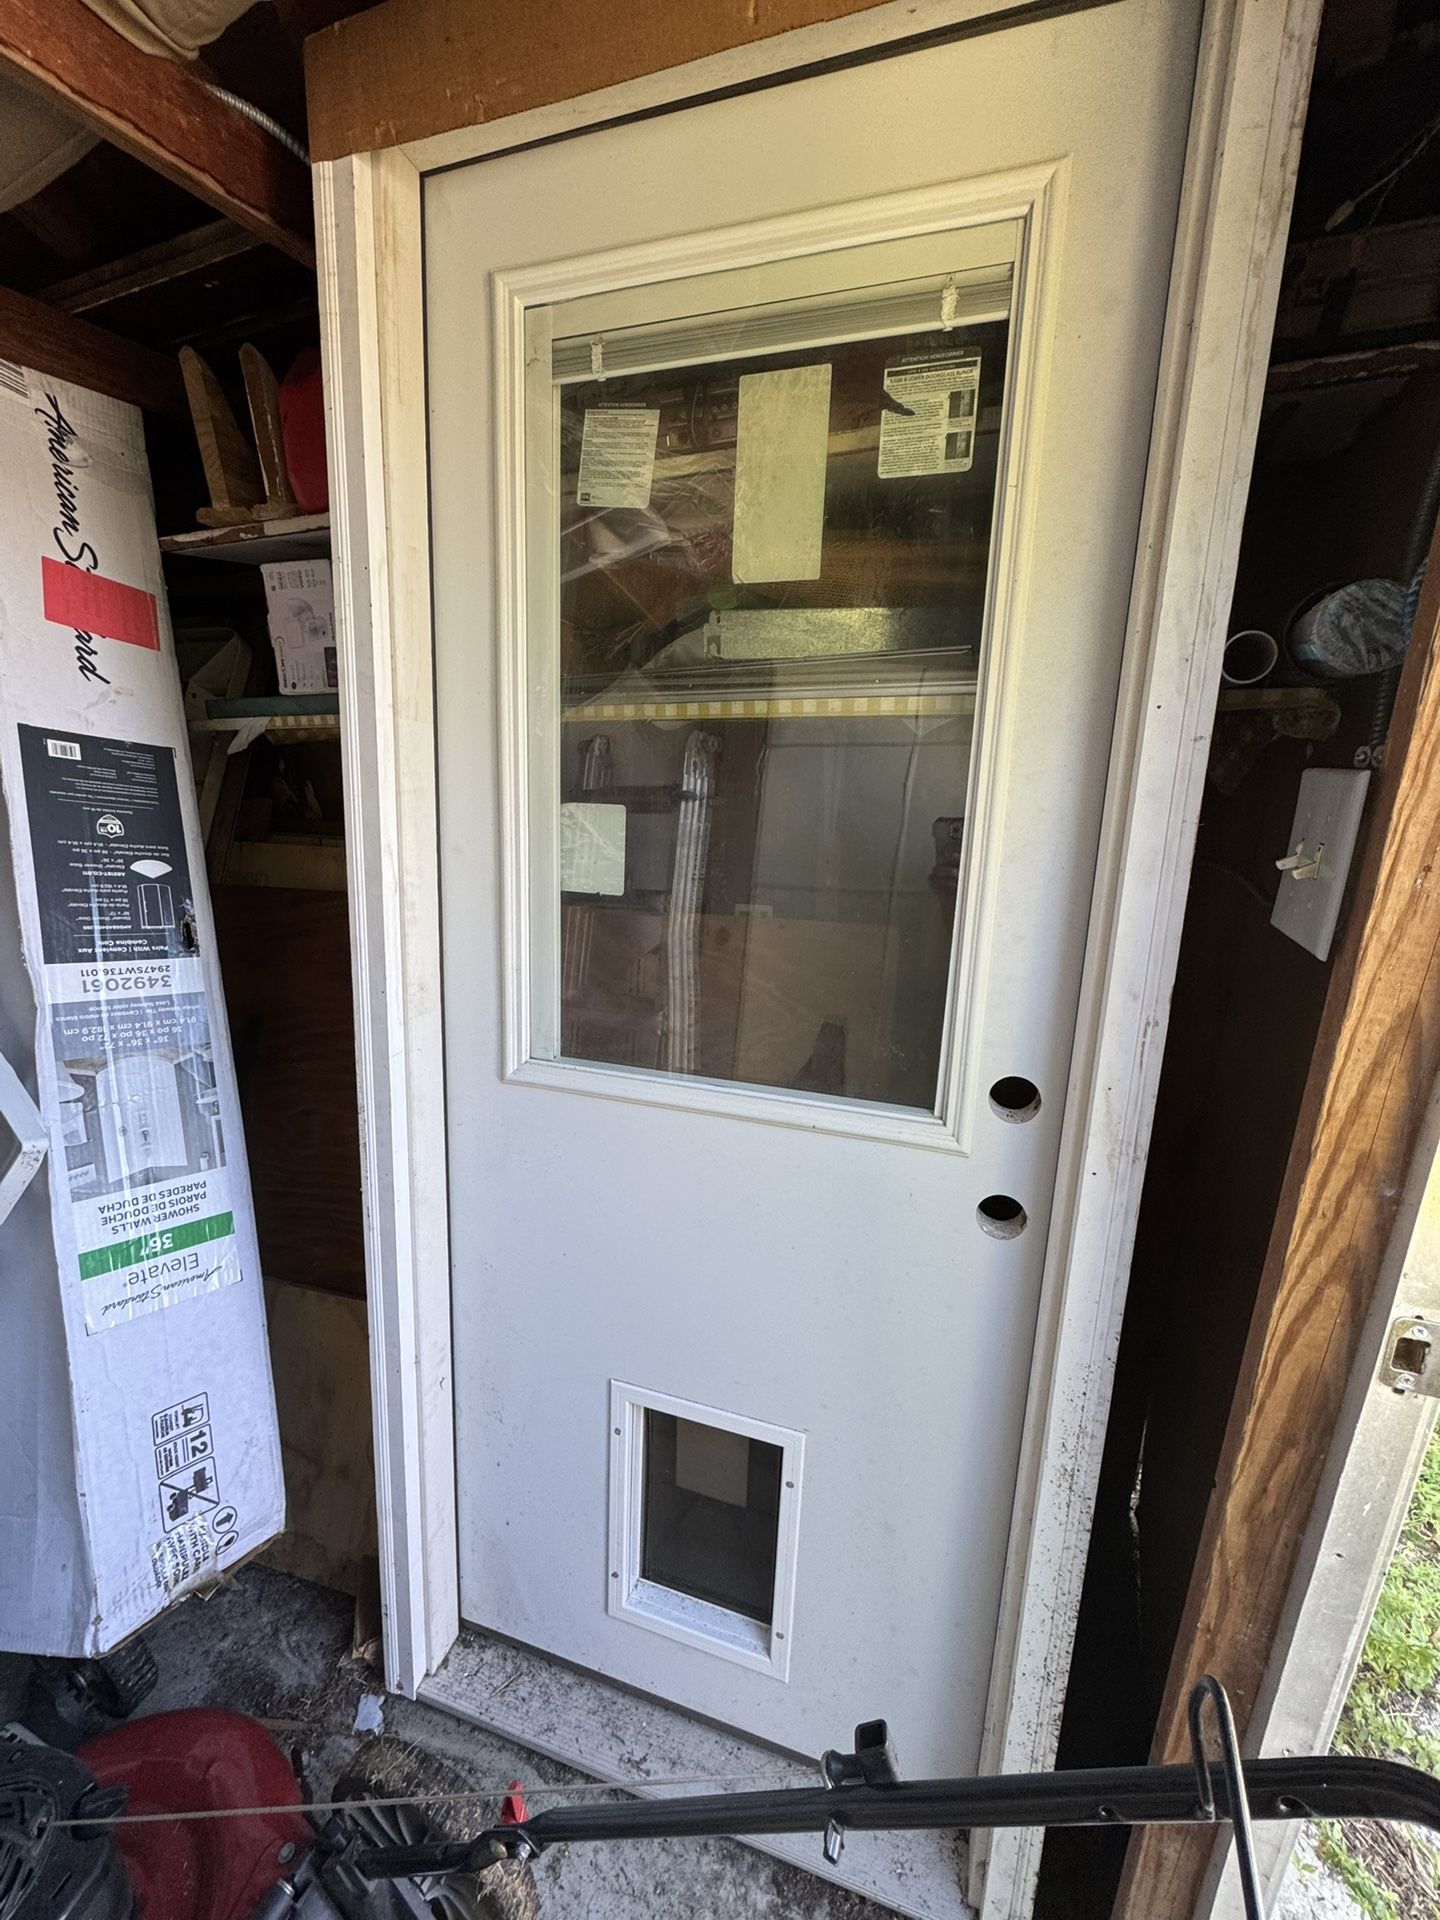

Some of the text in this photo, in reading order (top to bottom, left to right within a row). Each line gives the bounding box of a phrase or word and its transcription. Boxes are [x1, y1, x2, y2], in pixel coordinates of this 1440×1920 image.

[35, 392, 80, 536] American
[107, 824, 122, 834] 10
[95, 946, 127, 954] Convient
[80, 964, 171, 978] 2947SWT36.011
[81, 974, 172, 994] 3492061
[134, 1020, 153, 1029] 91.4
[163, 1018, 177, 1026] cm
[179, 1016, 197, 1024] 91.4
[64, 1028, 79, 1036] cm
[118, 1023, 132, 1031] cm
[157, 1026, 169, 1034] po
[120, 1030, 132, 1038] po
[98, 1180, 207, 1214] PAREDES DE DUCHA
[100, 1191, 207, 1226] PAROIS DE DOUCHE
[111, 1203, 200, 1235] SHOWER WALLS
[100, 1265, 222, 1316] American Standard
[190, 1430, 208, 1458] 12
